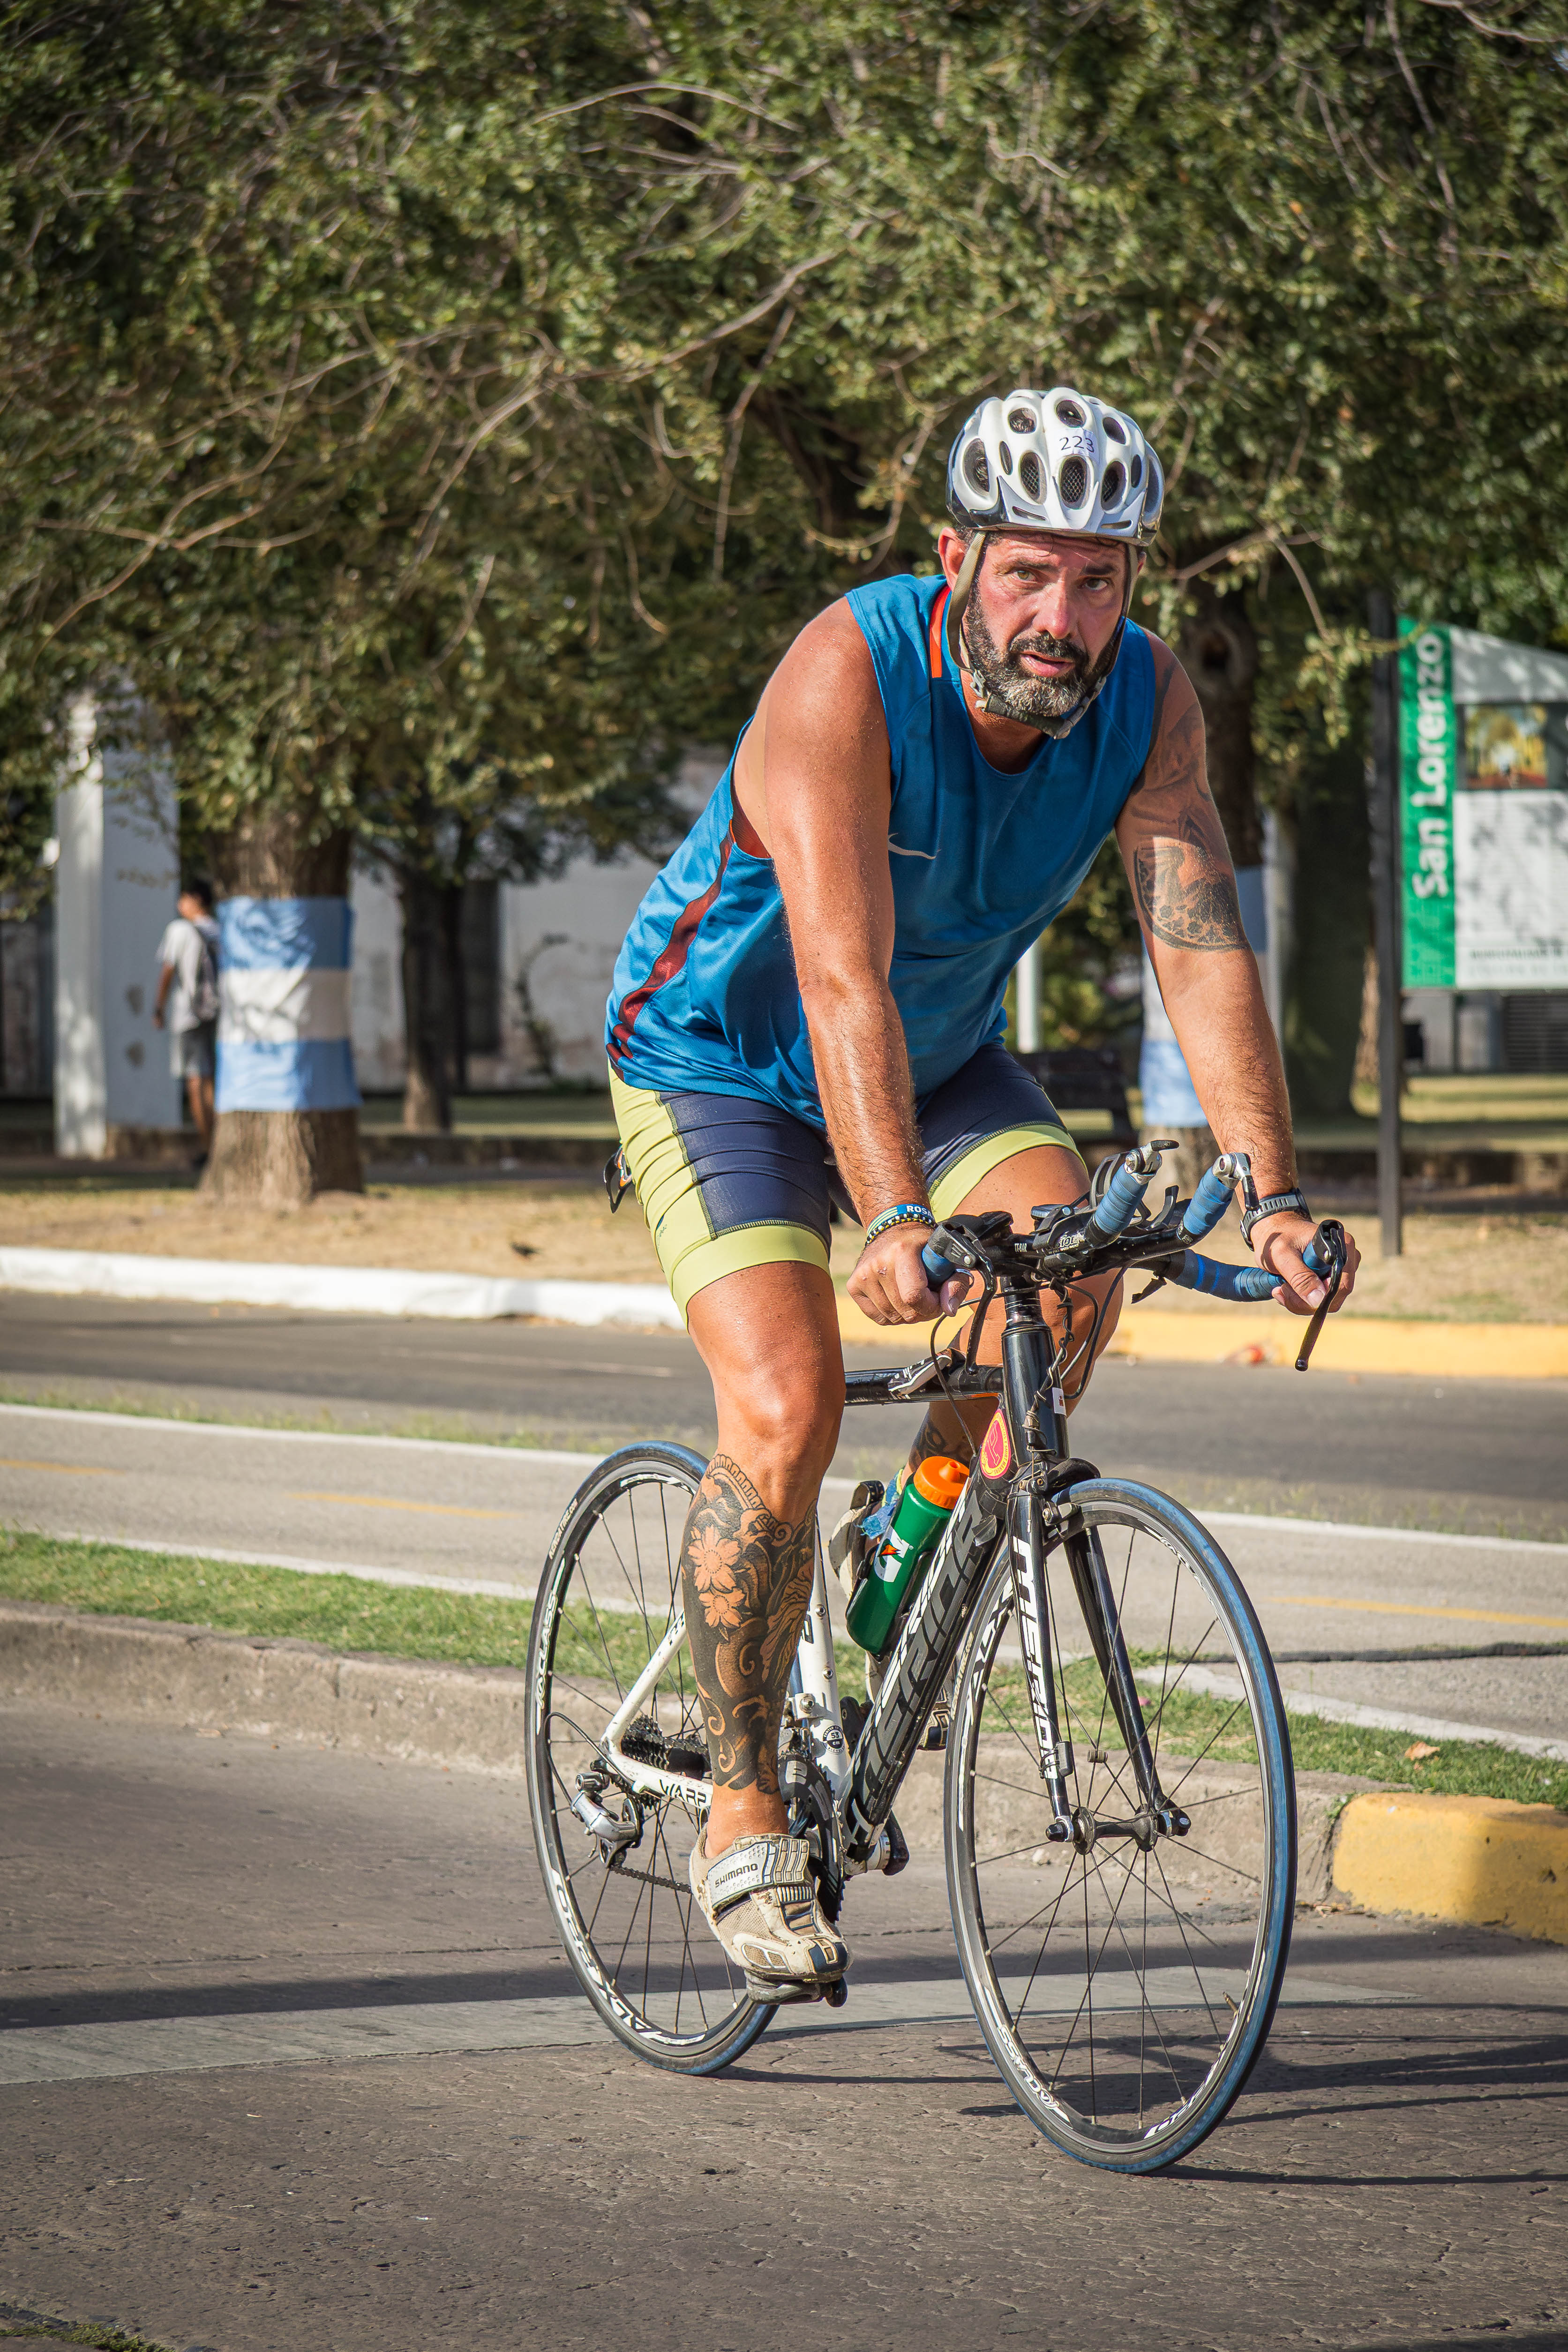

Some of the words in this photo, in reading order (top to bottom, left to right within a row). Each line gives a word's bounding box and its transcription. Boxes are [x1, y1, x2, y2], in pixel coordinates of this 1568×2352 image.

[1059, 435, 1095, 453] 223
[1412, 633, 1447, 807] Lorenzo
[1412, 817, 1448, 899] San
[1013, 1536, 1058, 1779] MERIDA
[715, 1863, 758, 1888] SHIMANO
